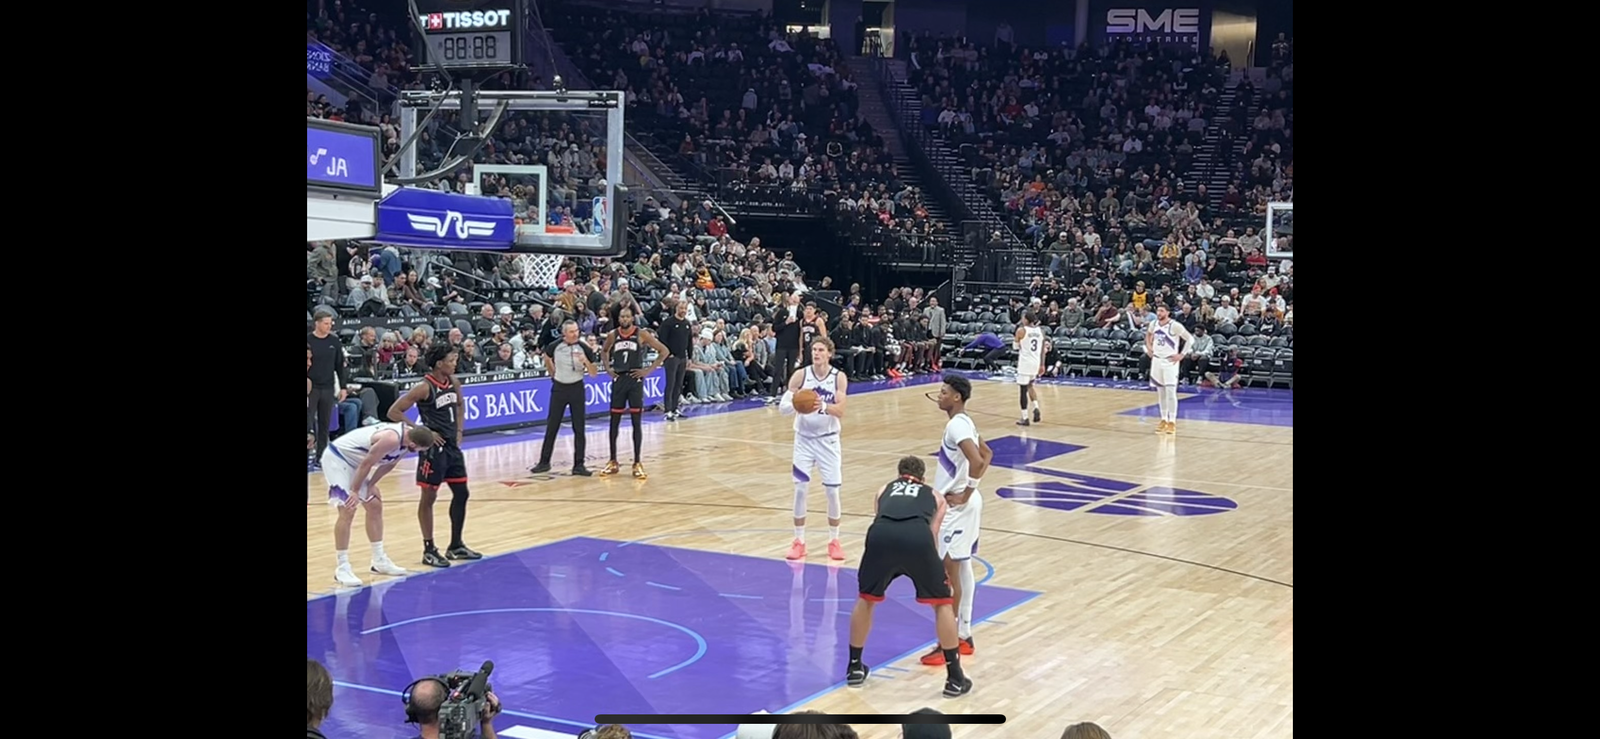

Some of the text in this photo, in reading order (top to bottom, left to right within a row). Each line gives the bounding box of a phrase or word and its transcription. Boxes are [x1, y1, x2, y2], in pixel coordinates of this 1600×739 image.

[443, 9, 510, 28] TISSOT
[1106, 8, 1199, 33] SME
[1108, 35, 1199, 43] IDSTRIES
[326, 156, 348, 178] JA
[1030, 338, 1038, 352] 3
[622, 351, 629, 364] 7
[470, 375, 487, 383] DELTA
[449, 406, 455, 422] 1
[890, 482, 921, 498] 28
